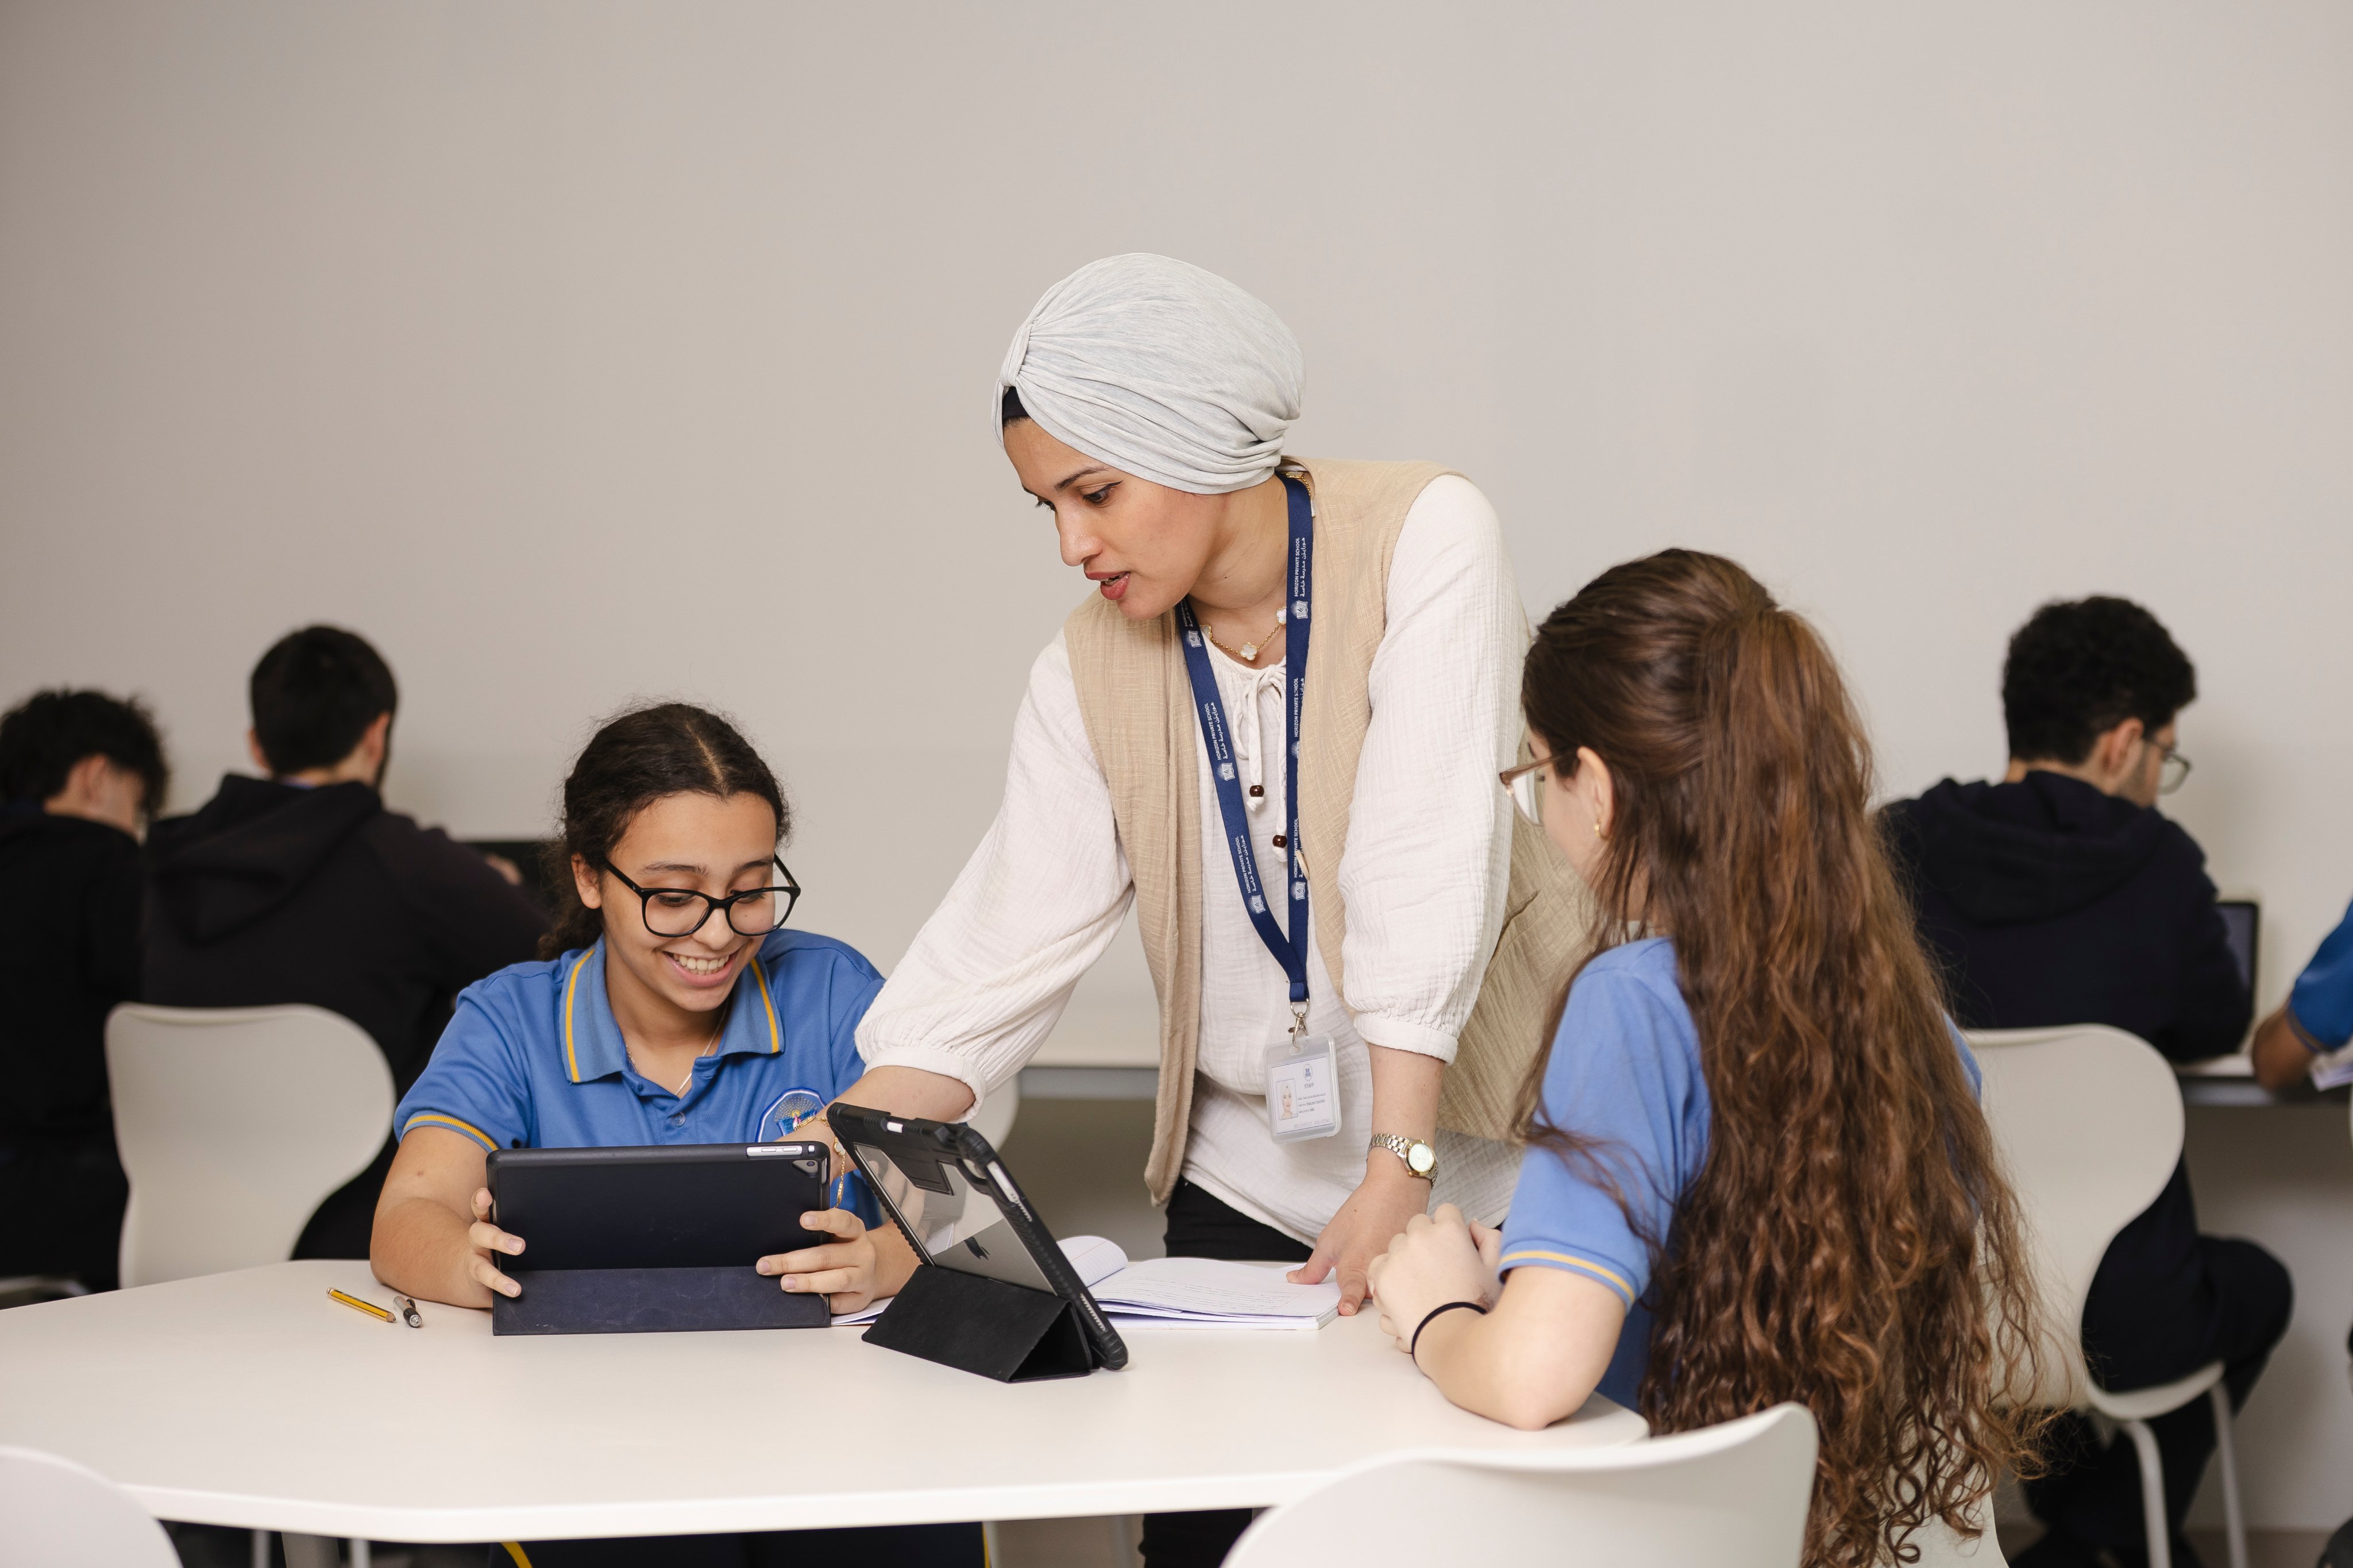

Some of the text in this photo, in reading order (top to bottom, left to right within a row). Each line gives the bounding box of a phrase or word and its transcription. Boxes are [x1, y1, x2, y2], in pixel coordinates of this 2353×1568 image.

[1204, 702, 1212, 721] SCHOOL
[1213, 739, 1222, 760] HORIZON
[1243, 872, 1251, 894] HORIZON
